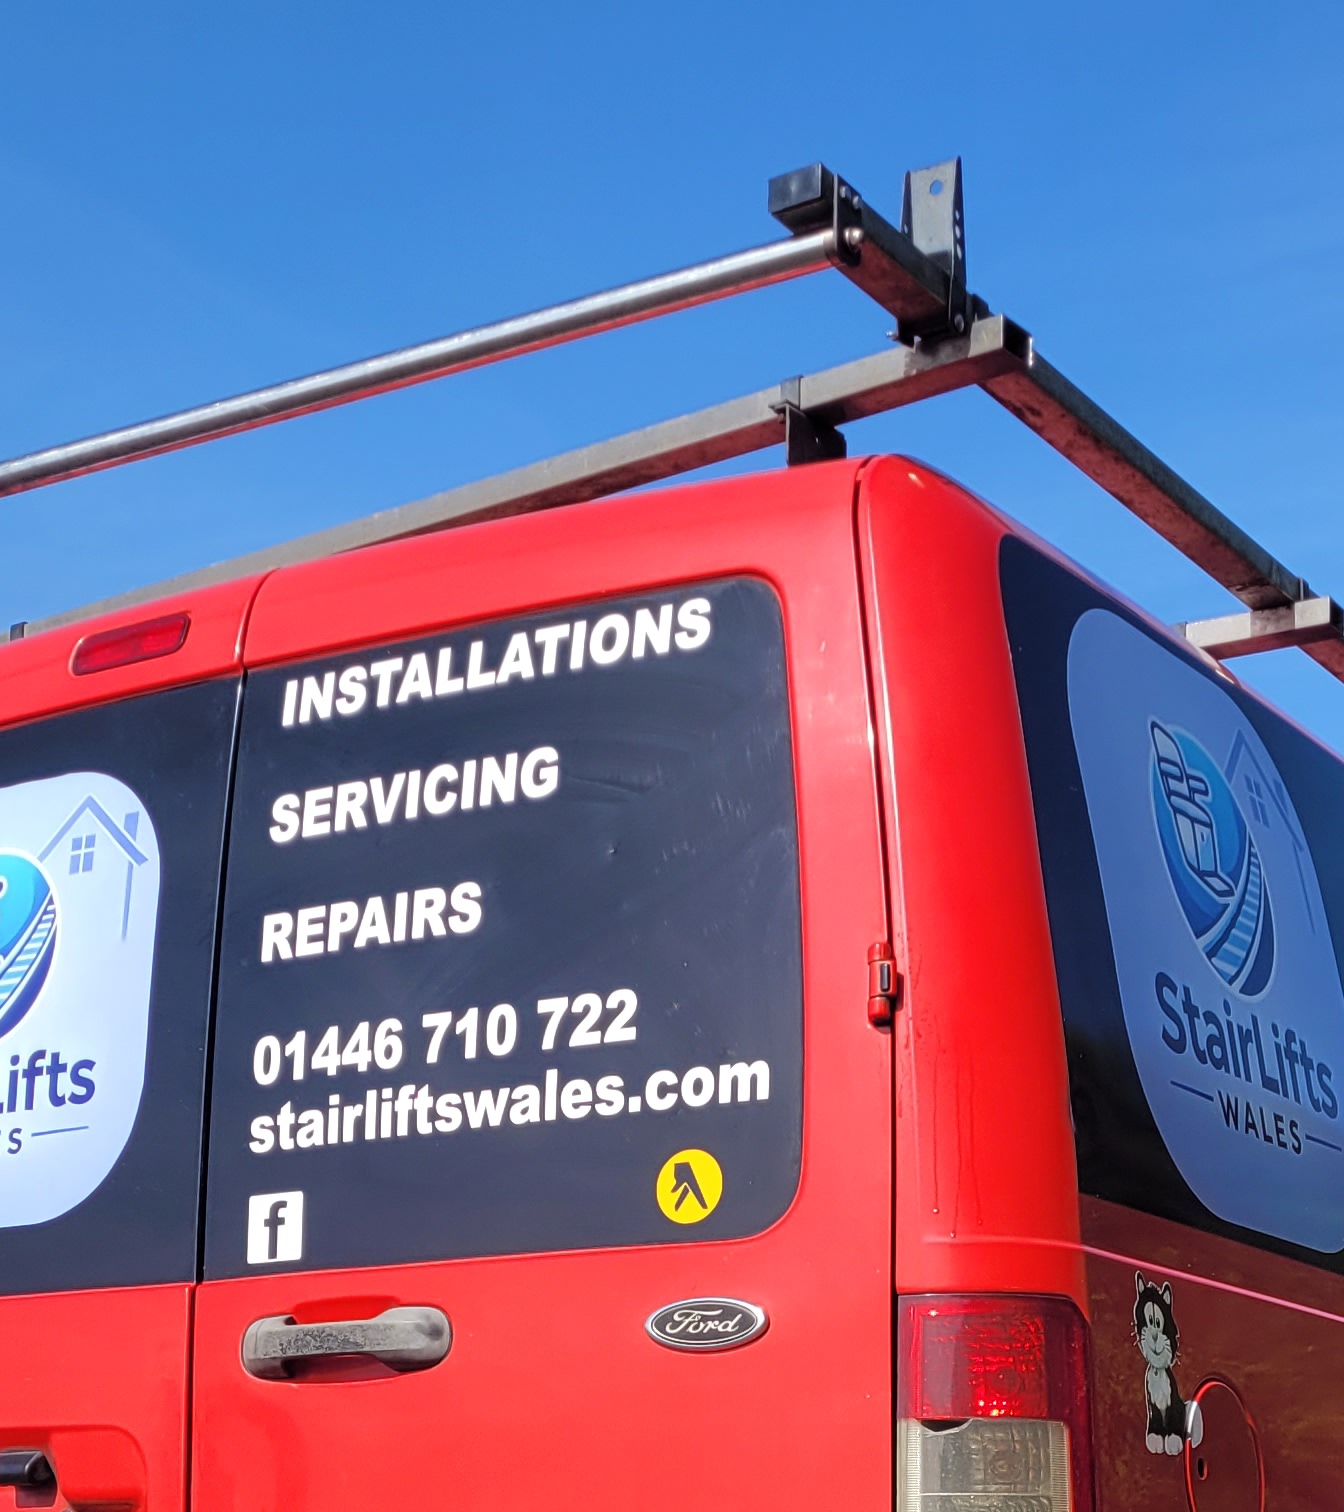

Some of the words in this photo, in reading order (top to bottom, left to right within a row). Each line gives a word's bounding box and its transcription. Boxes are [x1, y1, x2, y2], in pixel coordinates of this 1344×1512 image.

[281, 598, 711, 726] INSTALLATIONS
[268, 747, 560, 843] SERVICING
[260, 883, 482, 962] REPAIRS
[253, 1018, 404, 1086] 01446
[422, 998, 517, 1065] 710
[536, 989, 638, 1053] 722
[1155, 971, 1338, 1119] StairLifts
[249, 1060, 771, 1154] stairliftswales.com
[1217, 1089, 1302, 1155] WALES
[665, 1309, 743, 1334] Ford
